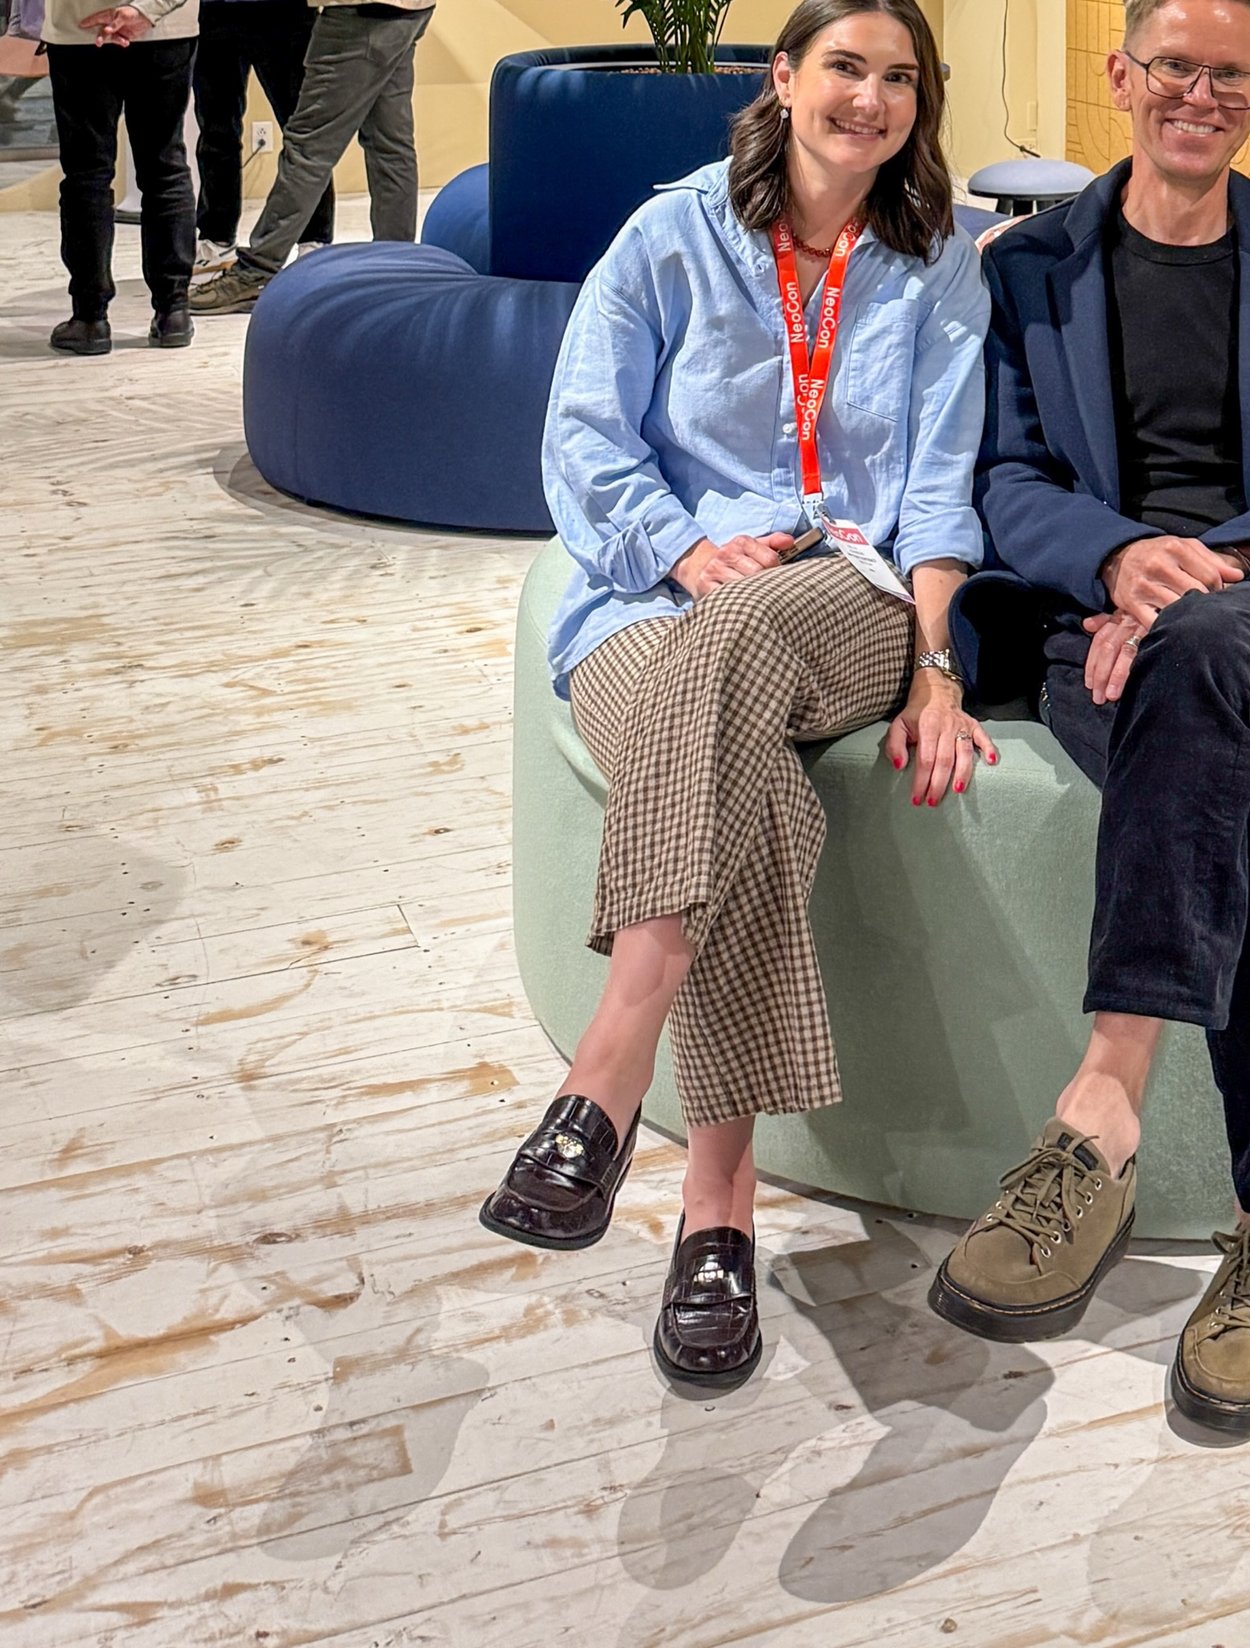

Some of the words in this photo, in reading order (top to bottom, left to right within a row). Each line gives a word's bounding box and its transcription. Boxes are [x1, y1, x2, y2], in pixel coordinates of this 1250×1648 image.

[778, 222, 791, 251] Neo
[786, 282, 804, 343] NeoCon
[818, 287, 841, 349] NeoCon
[802, 378, 825, 441] NeoCon
